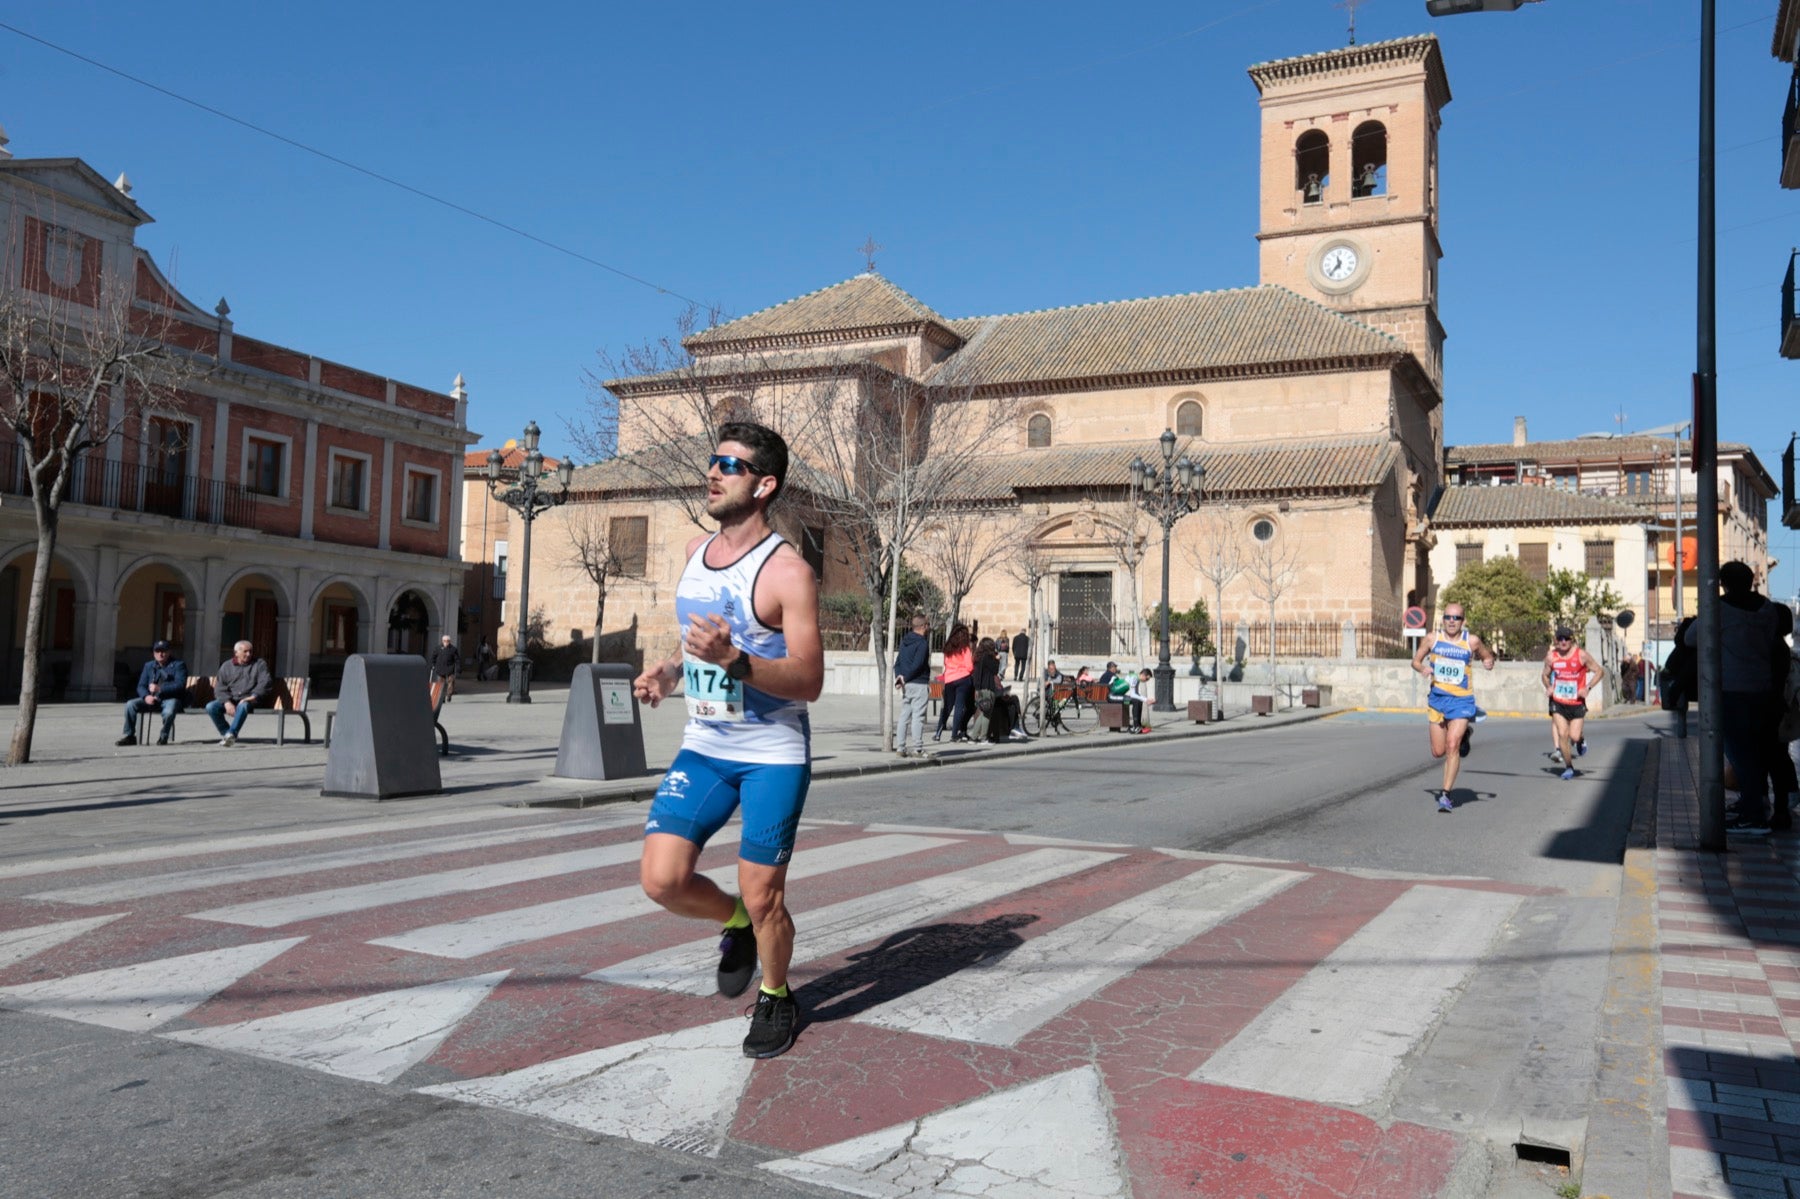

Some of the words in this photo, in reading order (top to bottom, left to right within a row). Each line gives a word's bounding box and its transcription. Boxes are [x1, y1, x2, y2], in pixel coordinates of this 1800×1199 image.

[1439, 665, 1459, 677] 499
[687, 668, 735, 694] 1174
[1558, 685, 1574, 694] 712
